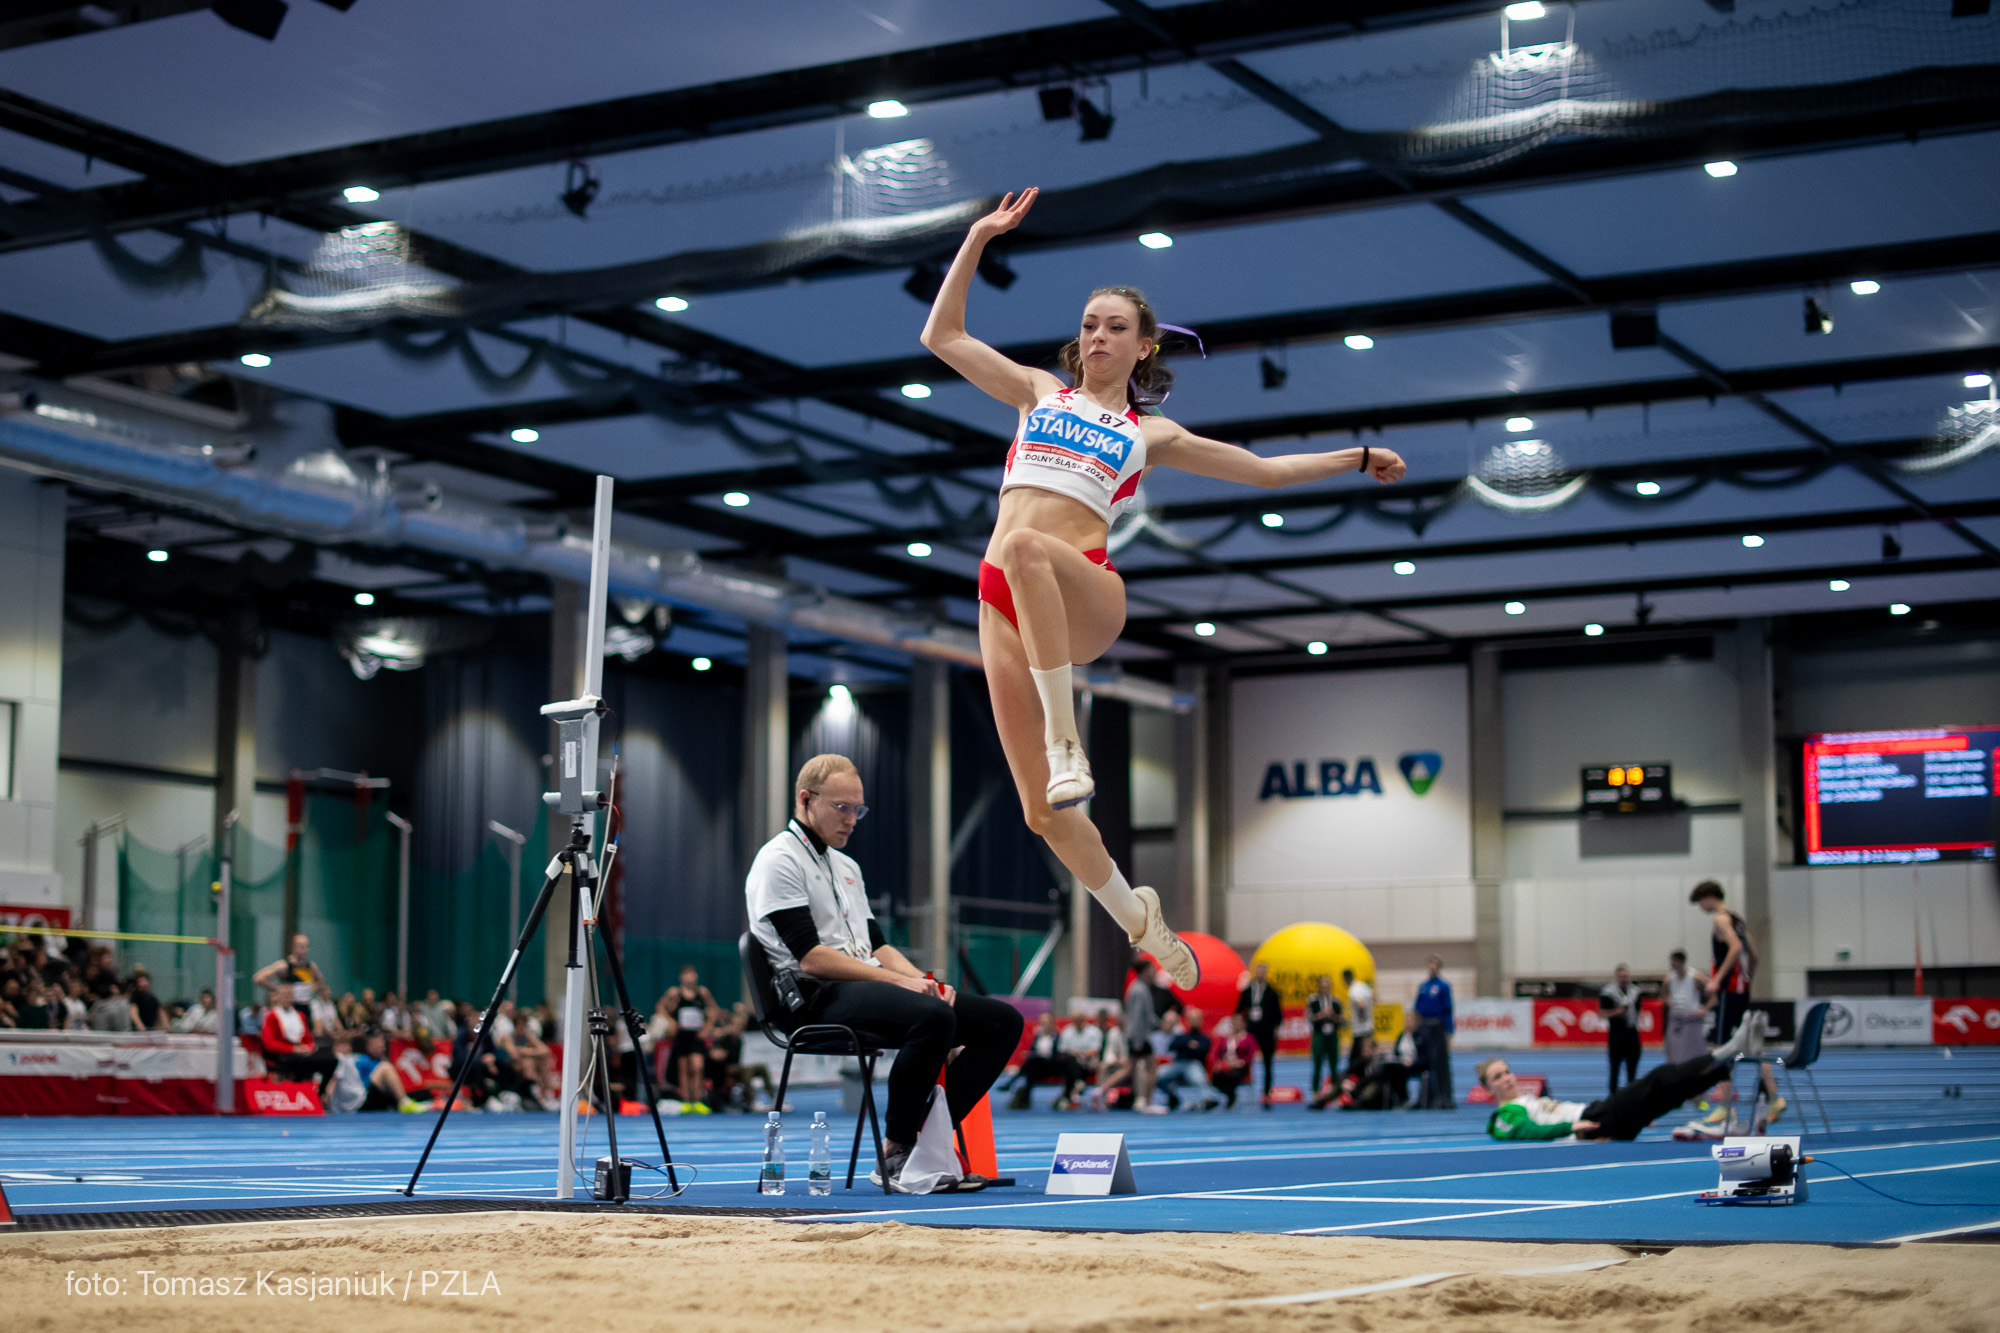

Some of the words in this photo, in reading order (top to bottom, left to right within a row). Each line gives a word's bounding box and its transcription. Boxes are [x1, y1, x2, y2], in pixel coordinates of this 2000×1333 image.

[1098, 413, 1128, 428] 87
[1028, 414, 1124, 461] STAWSKA
[1025, 453, 1054, 463] DOLNY
[1055, 456, 1083, 470] ŚLĄSK
[1084, 465, 1106, 482] 2024
[1259, 760, 1383, 800] ALBA
[254, 1090, 315, 1111] PZLA
[1070, 1159, 1110, 1170] polanik
